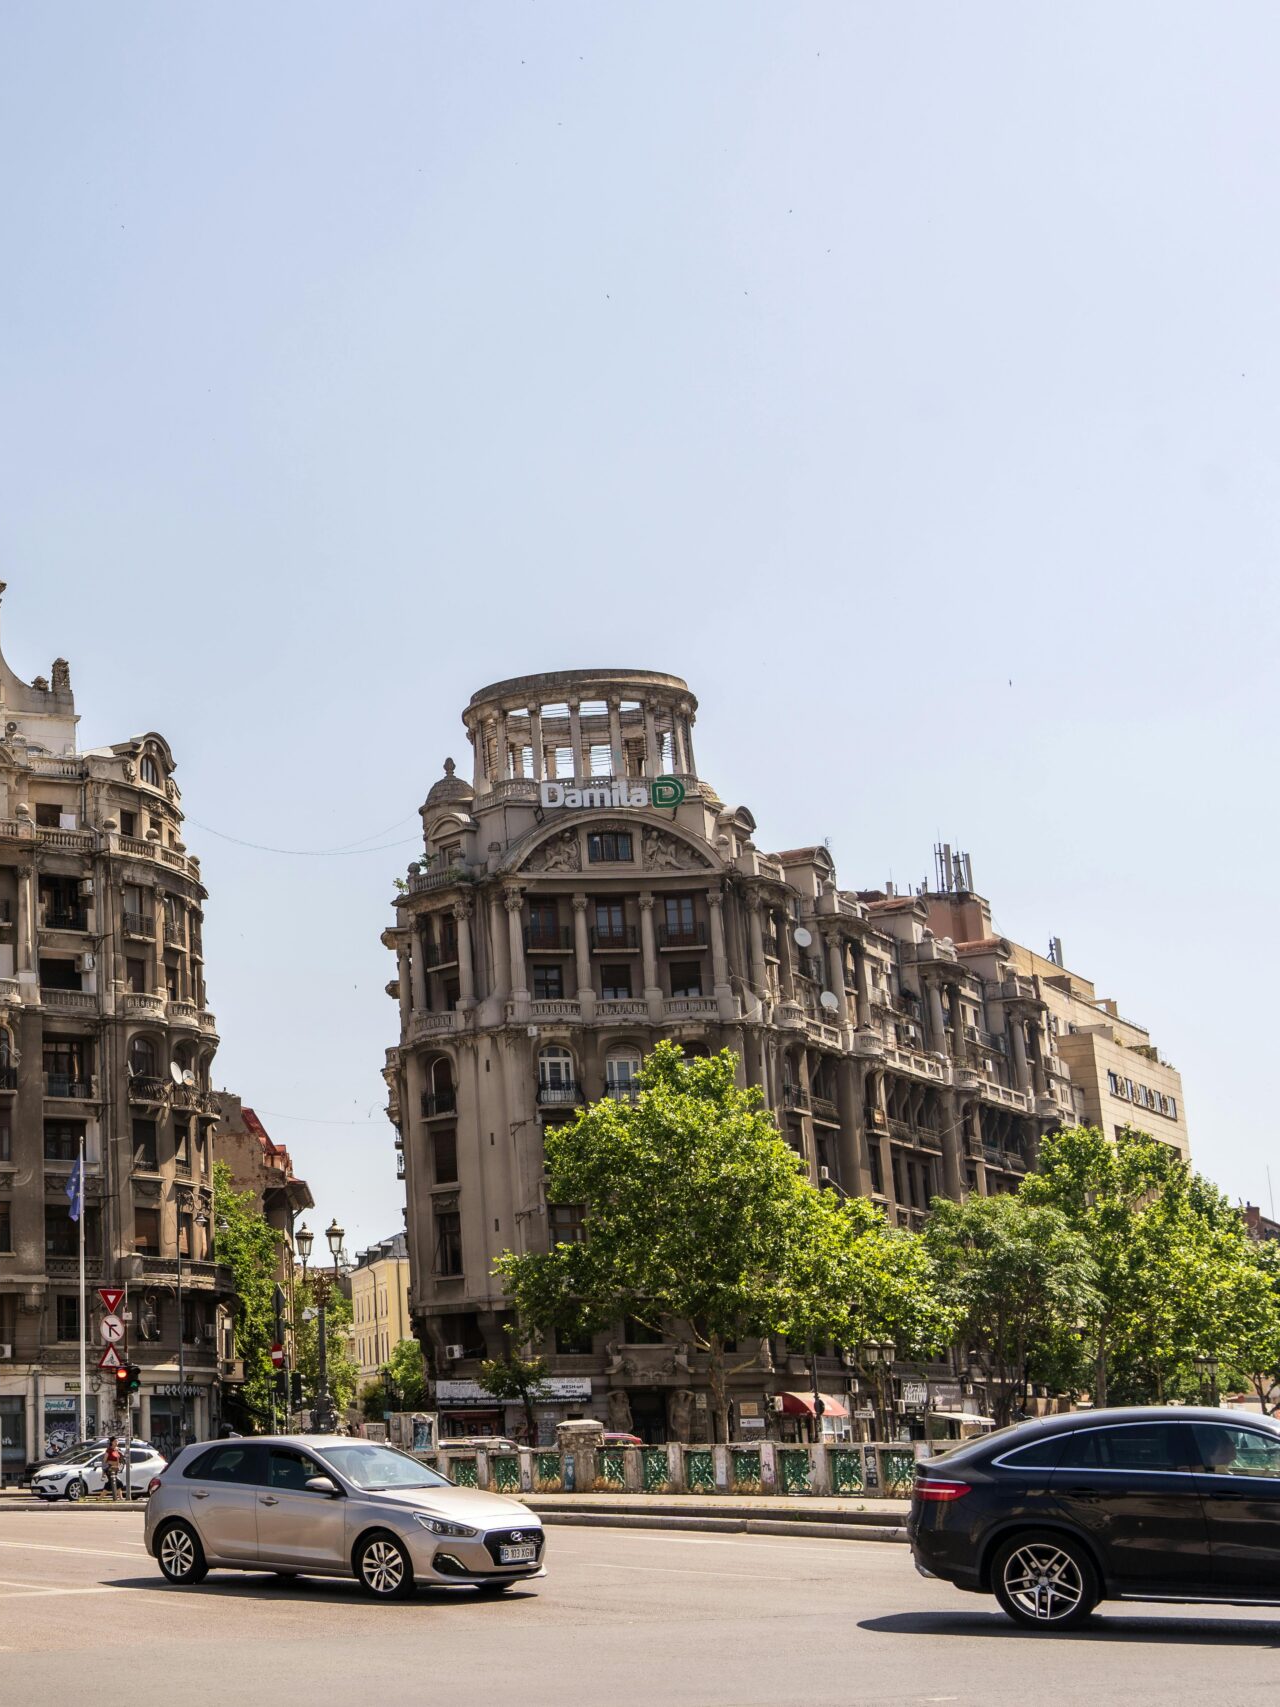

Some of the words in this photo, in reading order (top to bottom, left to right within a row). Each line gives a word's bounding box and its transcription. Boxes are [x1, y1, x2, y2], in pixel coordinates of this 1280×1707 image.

[541, 781, 648, 808] Damila
[505, 1549, 509, 1559] B
[511, 1548, 520, 1558] 103
[521, 1547, 535, 1558] XGW
